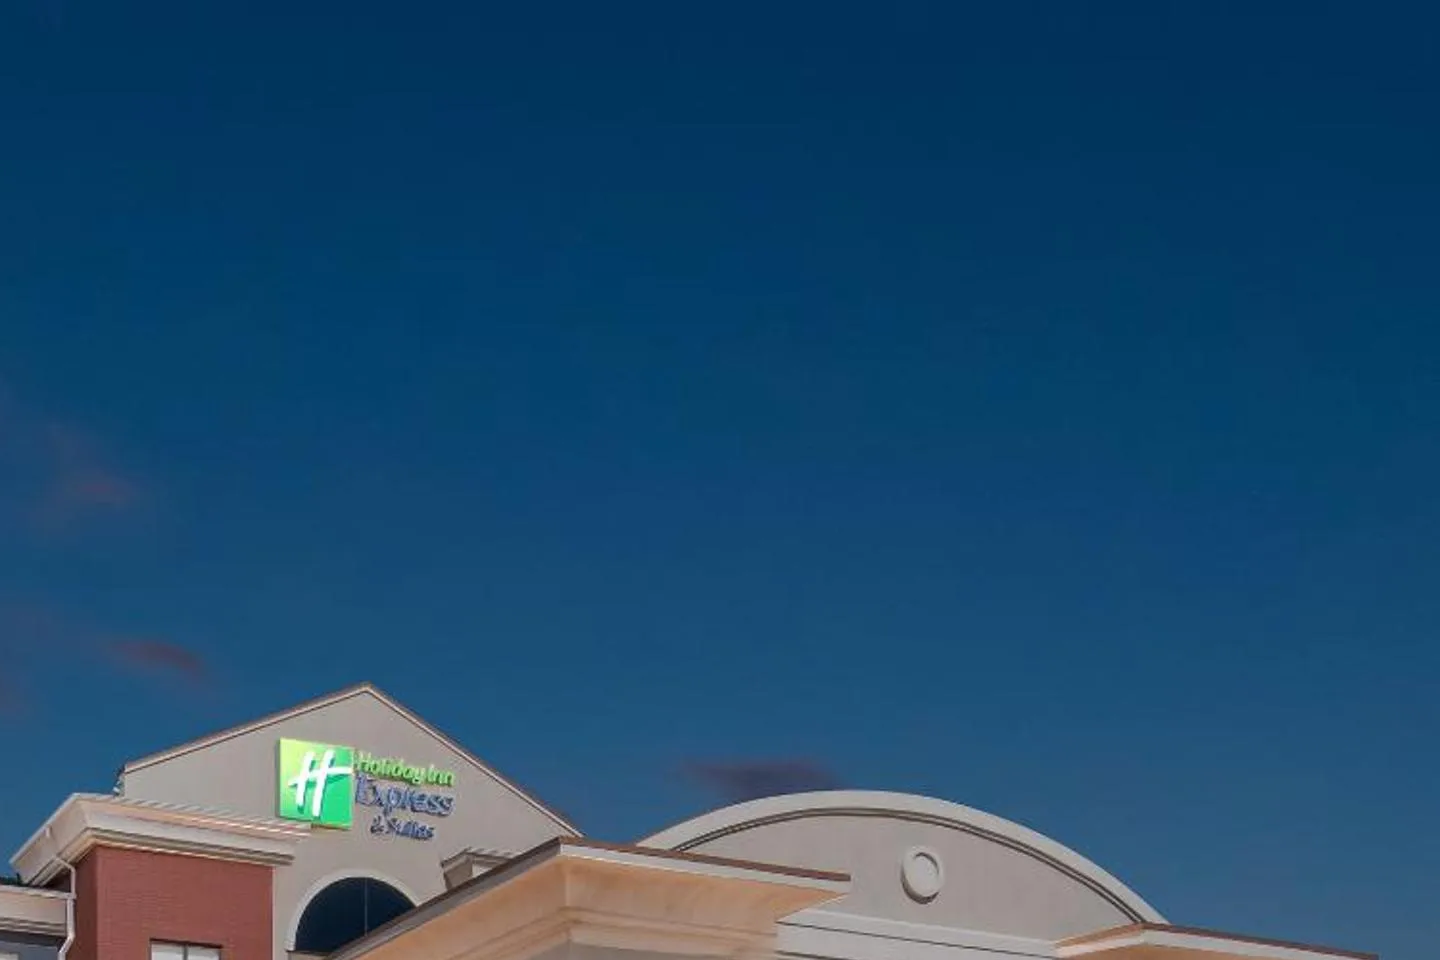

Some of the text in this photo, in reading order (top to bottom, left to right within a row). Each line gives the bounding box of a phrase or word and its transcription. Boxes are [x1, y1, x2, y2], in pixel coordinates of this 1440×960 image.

[356, 751, 455, 787] Holiday Inn
[356, 773, 454, 817] Express
